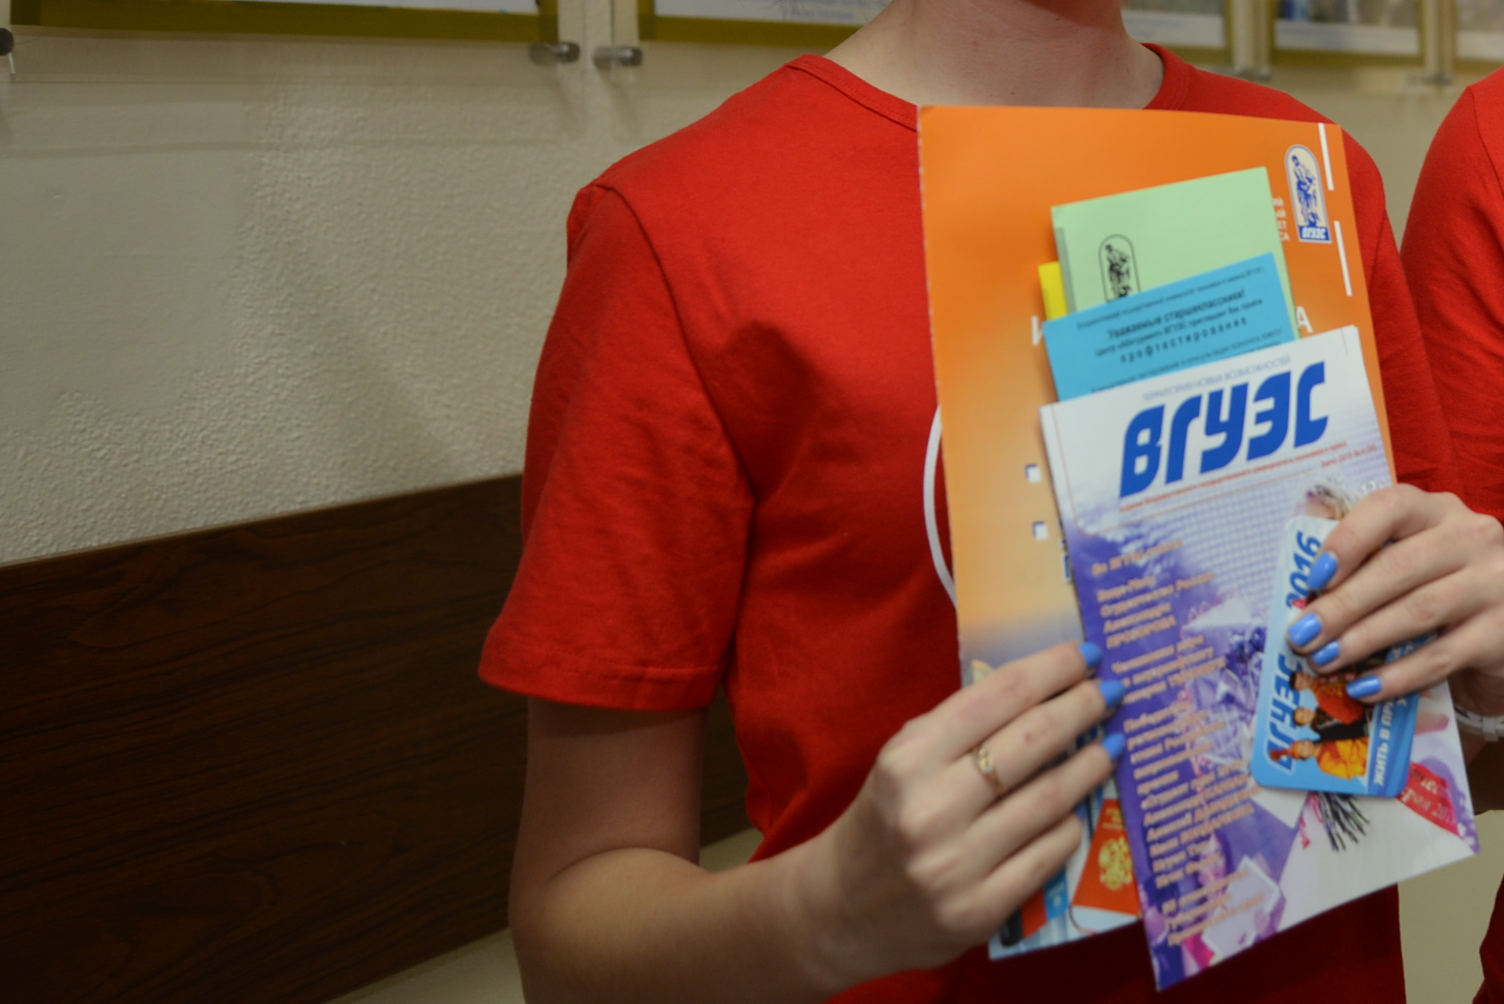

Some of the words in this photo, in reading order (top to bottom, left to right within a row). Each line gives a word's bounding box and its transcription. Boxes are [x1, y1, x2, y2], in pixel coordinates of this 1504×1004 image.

[1119, 360, 1329, 499] ВГУЭС
[1285, 531, 1321, 609] 2016
[1373, 738, 1389, 787] ЖИТЬ
